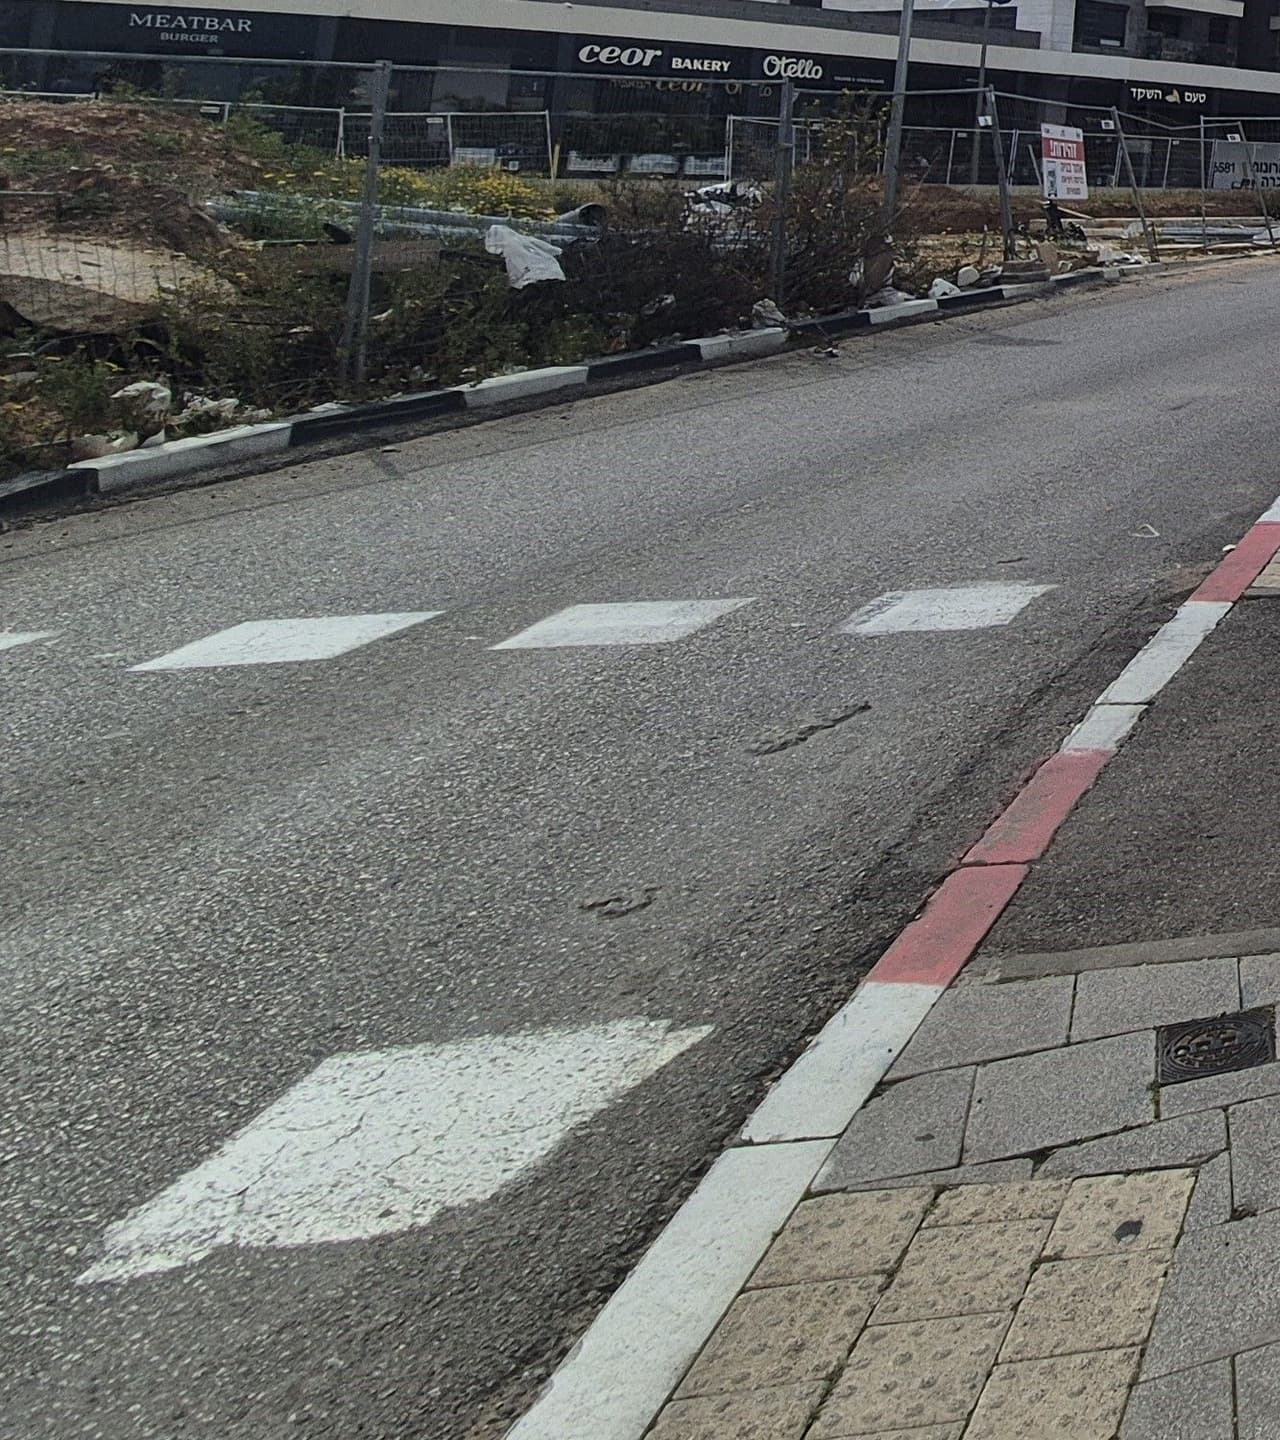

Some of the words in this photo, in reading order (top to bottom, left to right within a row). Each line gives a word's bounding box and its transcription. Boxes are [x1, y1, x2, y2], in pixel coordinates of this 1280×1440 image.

[129, 13, 253, 32] MEATBAR
[160, 32, 219, 43] BURGER
[578, 44, 663, 67] ceor
[671, 56, 731, 73] BAKERY
[763, 55, 823, 80] Otello
[1130, 87, 1163, 101] השקד
